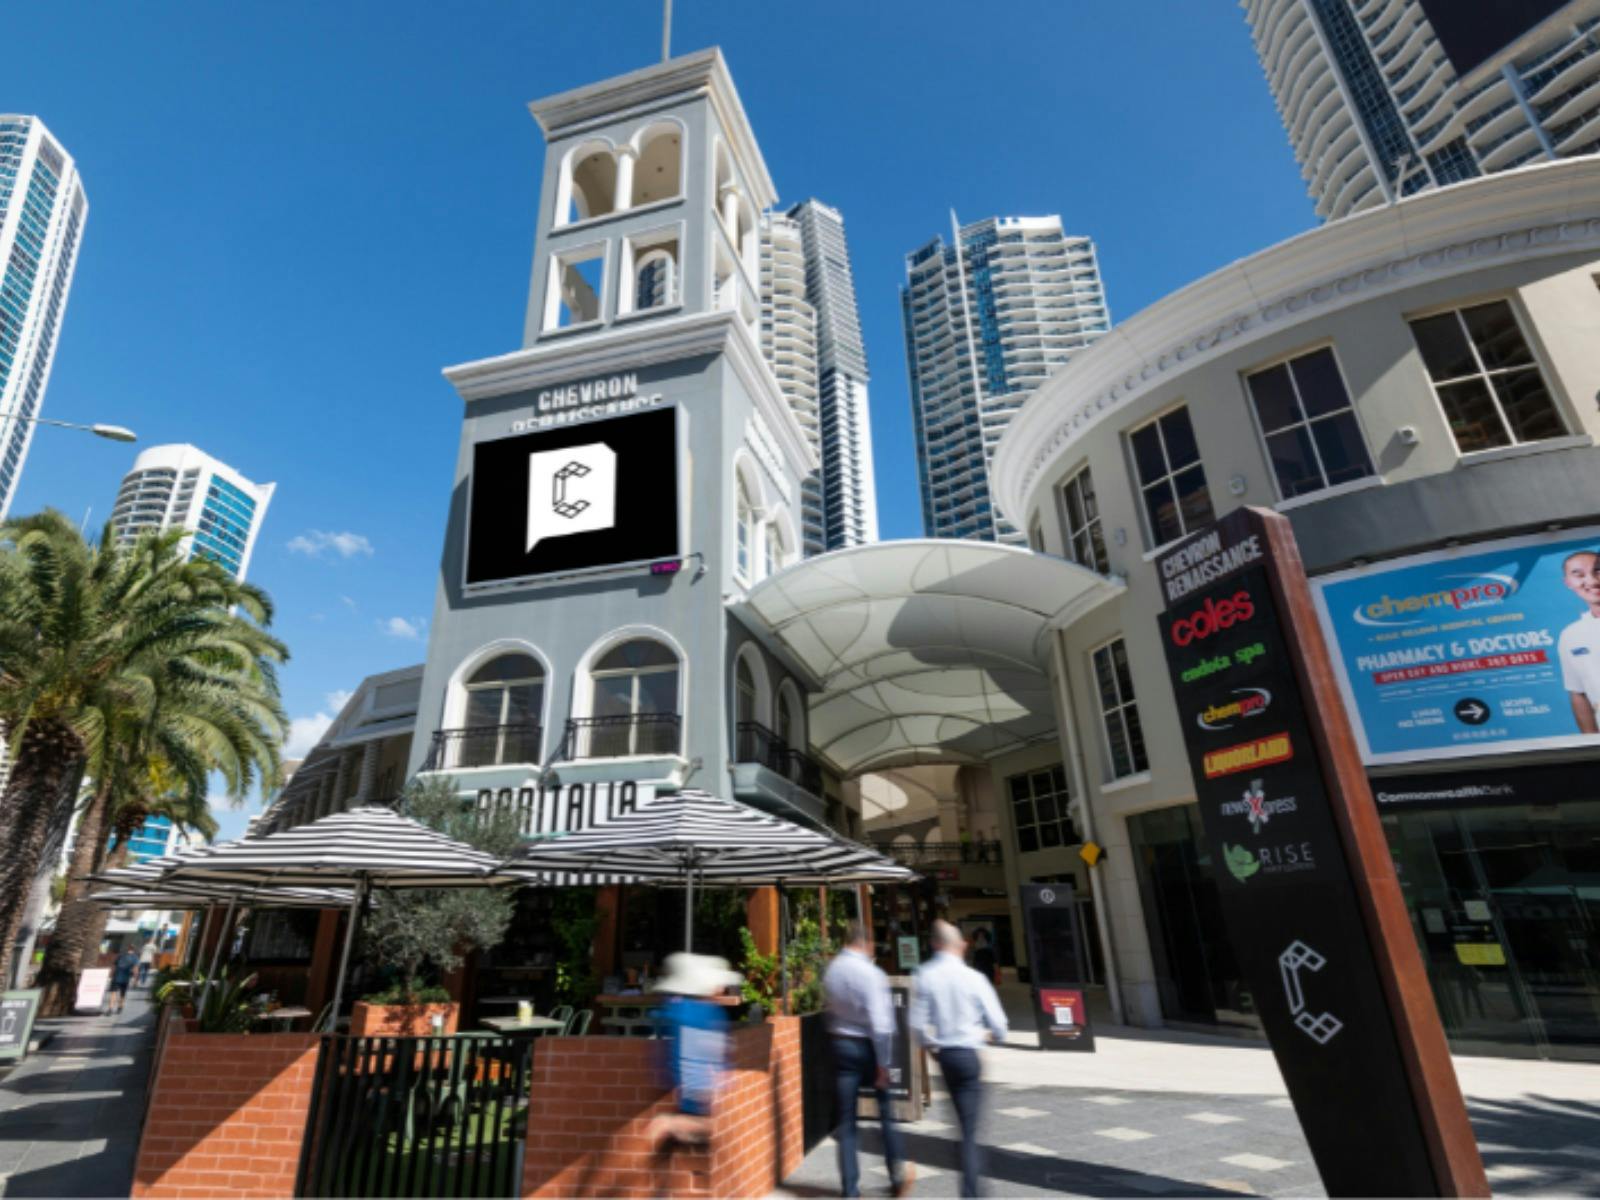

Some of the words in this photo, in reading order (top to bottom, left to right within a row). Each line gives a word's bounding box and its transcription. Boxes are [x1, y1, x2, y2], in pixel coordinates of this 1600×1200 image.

[538, 373, 638, 411] CHEVRON
[1162, 530, 1221, 578] CHEVRON
[1166, 535, 1263, 601] RENAISSANCE
[1171, 591, 1254, 646] coles
[1366, 582, 1505, 618] chempro
[1356, 644, 1445, 672] PHARMACY
[1451, 641, 1466, 657] &
[1468, 629, 1553, 653] DOCTORS
[1511, 653, 1538, 666] DAYS
[1203, 694, 1265, 723] chempro
[1204, 738, 1289, 774] LIQUORLAND
[1259, 842, 1313, 865] RISE
